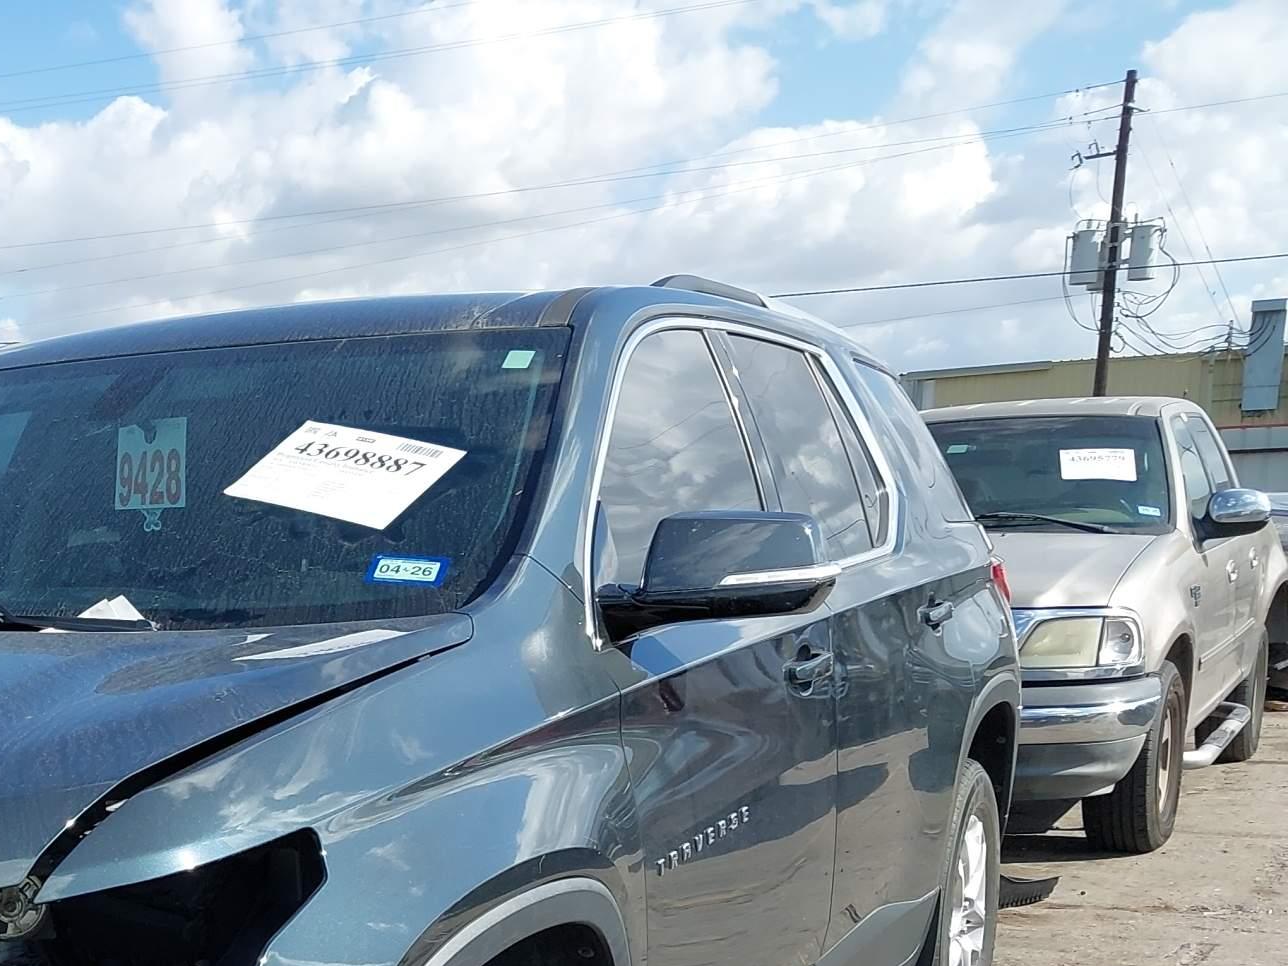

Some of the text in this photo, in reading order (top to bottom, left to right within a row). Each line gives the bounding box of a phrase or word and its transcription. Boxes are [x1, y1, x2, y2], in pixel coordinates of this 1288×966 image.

[118, 448, 182, 507] 9428
[294, 440, 427, 476] 43698887
[379, 563, 434, 577] 04 26
[655, 805, 750, 877] TRAVERSE
